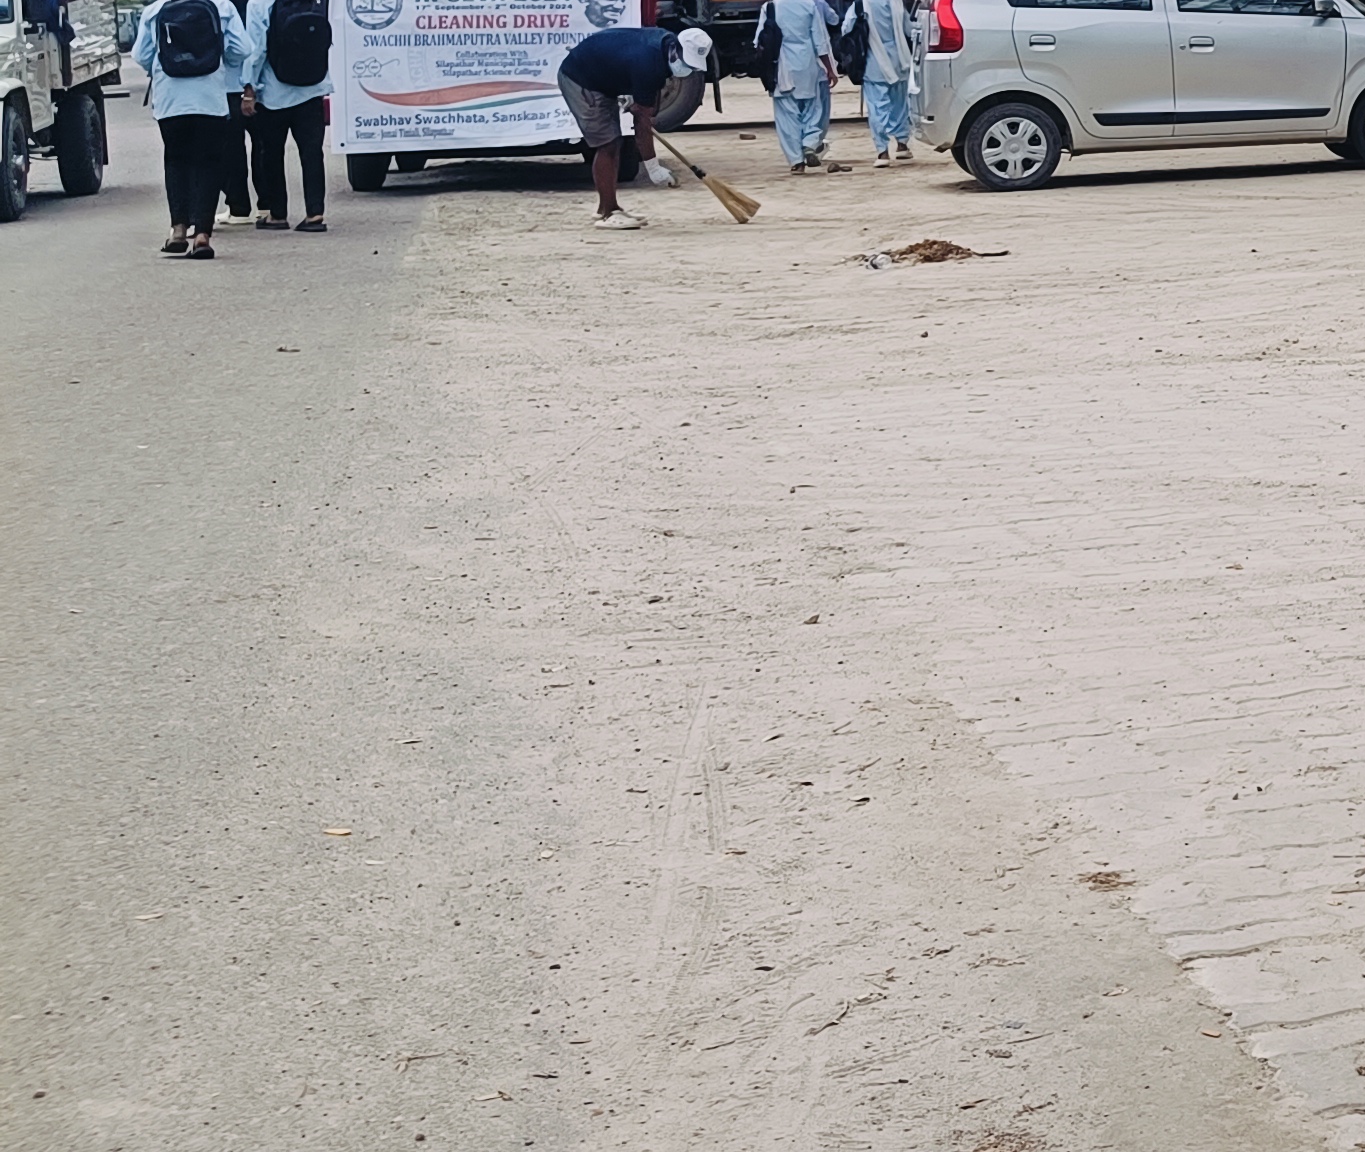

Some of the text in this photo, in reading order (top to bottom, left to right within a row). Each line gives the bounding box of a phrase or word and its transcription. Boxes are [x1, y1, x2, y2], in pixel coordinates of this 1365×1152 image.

[415, 14, 570, 30] CLEANING DRIVE
[414, 32, 501, 47] BRAHMAPUTRA
[503, 32, 545, 46] VALLEY
[547, 32, 594, 45] FOUND
[509, 50, 528, 58] With
[435, 60, 475, 69] Silapathar
[477, 59, 516, 68] Municipal
[517, 58, 541, 67] Board
[442, 68, 542, 78] Silapathar Science College
[355, 114, 412, 128] Swabhav
[414, 112, 490, 126] Swachhata,
[492, 110, 552, 123] Sanskaar
